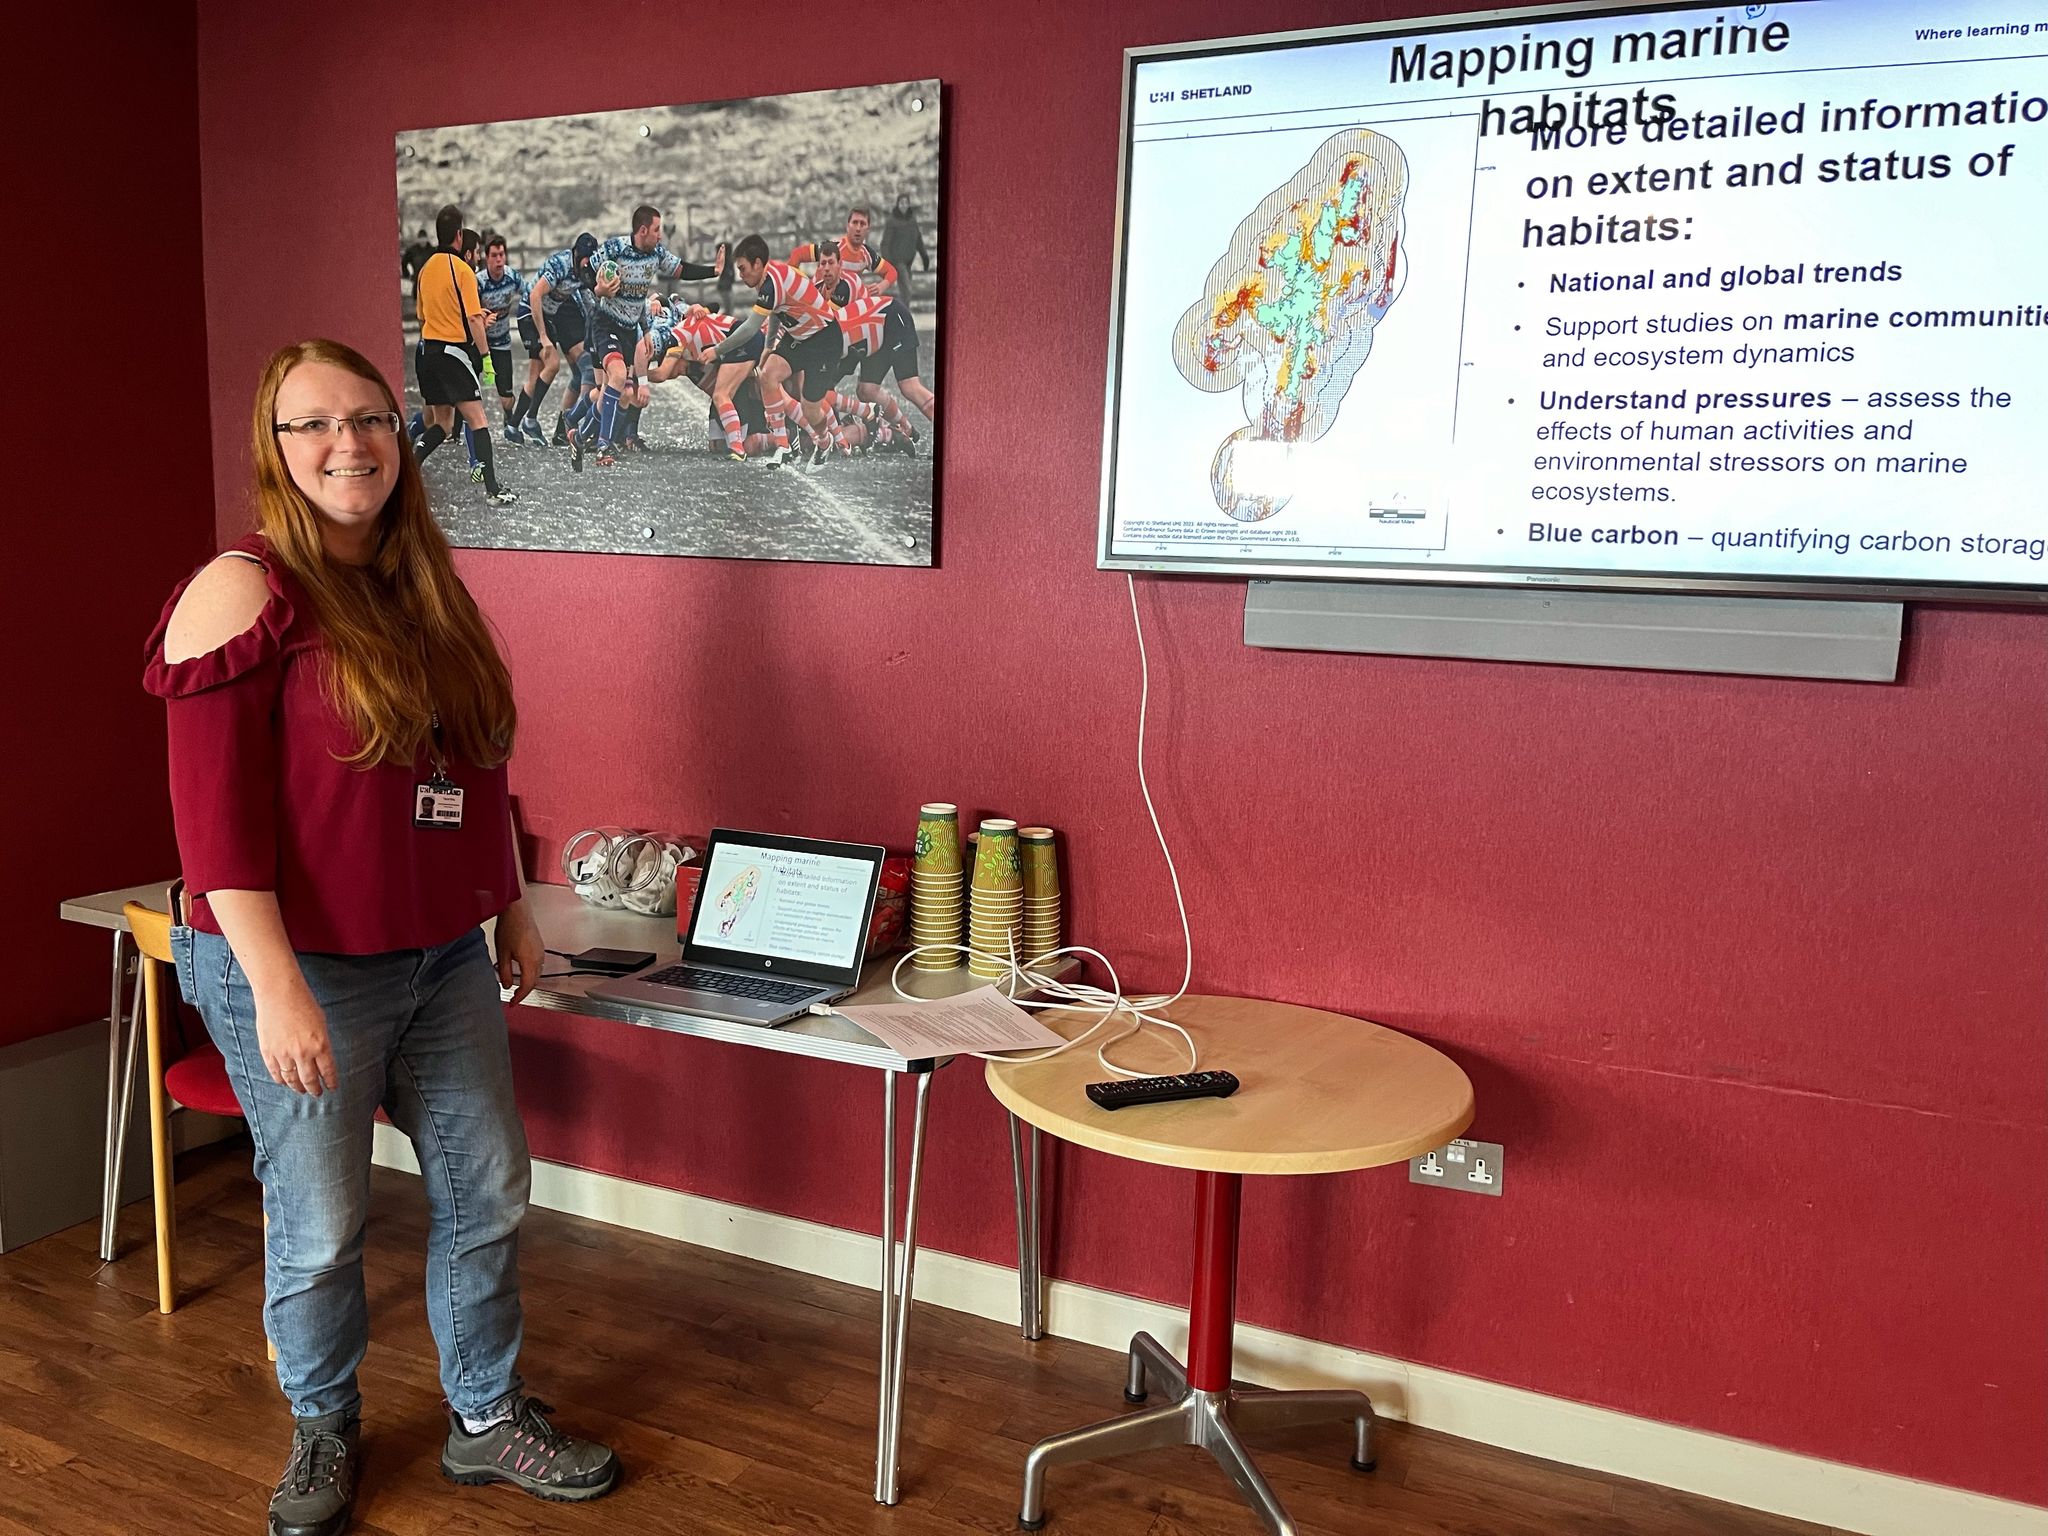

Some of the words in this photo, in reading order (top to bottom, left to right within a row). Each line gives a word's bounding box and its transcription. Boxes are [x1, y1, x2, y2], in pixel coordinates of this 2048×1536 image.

[1915, 28, 1962, 41] Where
[1968, 23, 2029, 37] learning
[1389, 33, 1594, 87] Mapping
[1611, 16, 1790, 63] marine
[1181, 85, 1252, 100] SHETLAND
[1480, 88, 1676, 137] habitats
[1531, 120, 1627, 151] More
[1642, 103, 1805, 142] detailed
[1821, 91, 2048, 132] informatio
[1527, 175, 1572, 199] on
[1588, 160, 1713, 195] extent
[1726, 153, 1803, 187] and
[1818, 150, 1951, 183] status
[1969, 144, 2015, 177] of
[1523, 215, 1692, 248] habitats:
[1550, 269, 1654, 293] National
[1663, 267, 1711, 288] and
[1720, 263, 1804, 292] global
[1814, 261, 1902, 283] trends
[1546, 316, 1638, 341] Support
[1646, 312, 1733, 333] studies
[1743, 316, 1772, 330] on
[1784, 308, 1879, 329] marine
[1543, 348, 1585, 367] and
[1594, 346, 1723, 370] ecosystem
[1733, 342, 1854, 368] dynamics
[1541, 389, 1686, 410] Understand
[1696, 392, 1831, 414] pressures
[1868, 392, 1960, 407] assess
[1971, 387, 2011, 407] the
[1537, 421, 1611, 440] effects
[1621, 421, 1644, 440] of
[1651, 421, 1733, 440] human
[1744, 420, 1853, 440] activities
[1864, 419, 1912, 440] and
[1535, 452, 1700, 471] environmental
[1709, 453, 1824, 471] stressors
[1835, 457, 1865, 472] on
[1877, 452, 1967, 473] marine
[1532, 483, 1675, 505] ecosystems.
[1529, 523, 1582, 542] Blue
[1592, 525, 1678, 545] carbon
[1712, 528, 1850, 554] quantifying
[1860, 530, 1950, 552] carbon
[1961, 534, 2048, 560] storag
[761, 852, 793, 864] Mapping
[794, 856, 820, 866] marine
